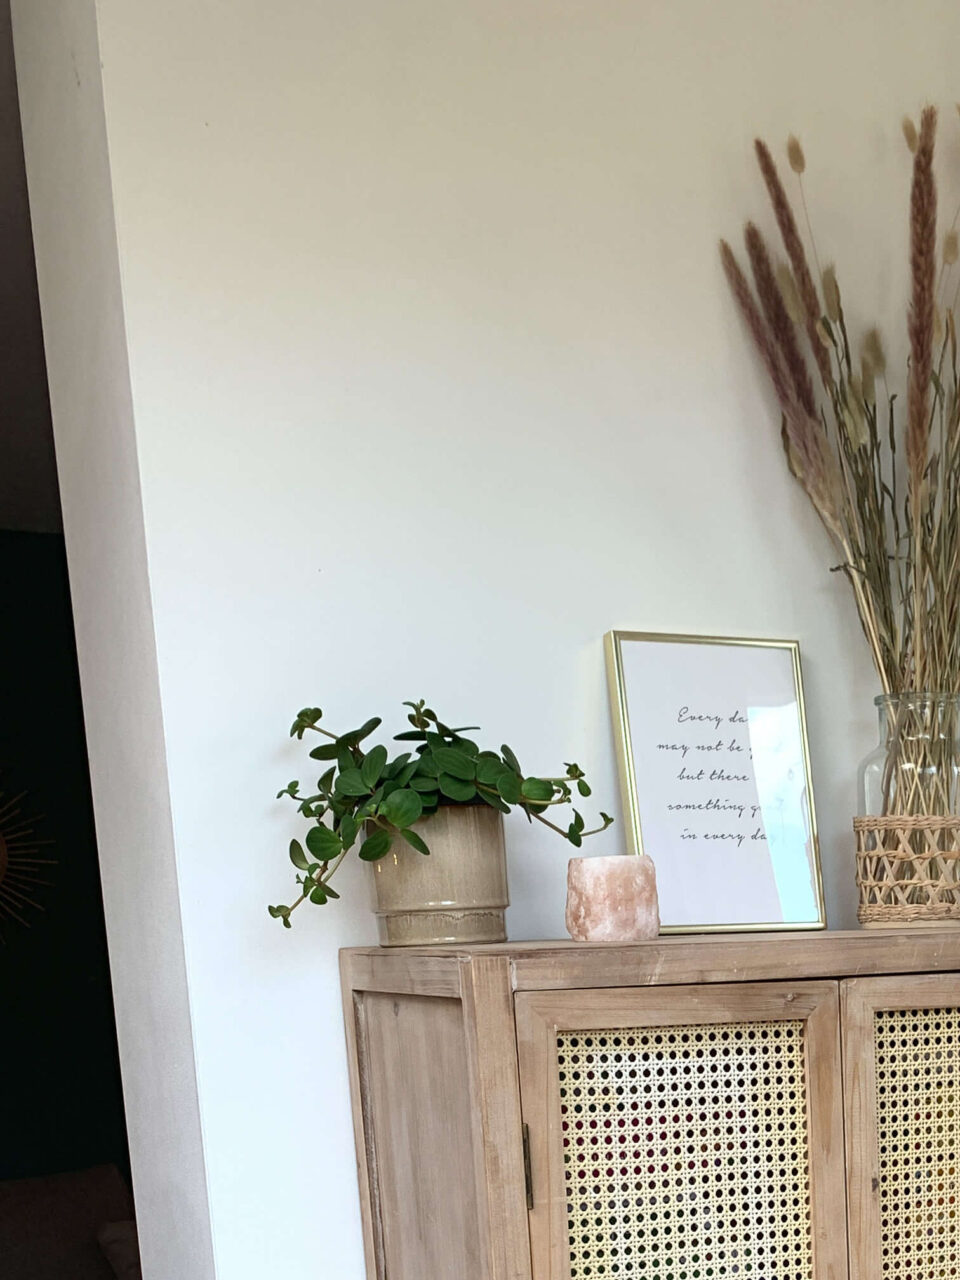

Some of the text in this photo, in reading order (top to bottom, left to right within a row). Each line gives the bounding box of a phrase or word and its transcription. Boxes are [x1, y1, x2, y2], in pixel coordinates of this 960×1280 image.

[677, 706, 749, 729] Every da
[657, 739, 744, 758] may not be
[677, 767, 750, 782] but there
[667, 799, 746, 818] something
[680, 828, 768, 847] in every da
